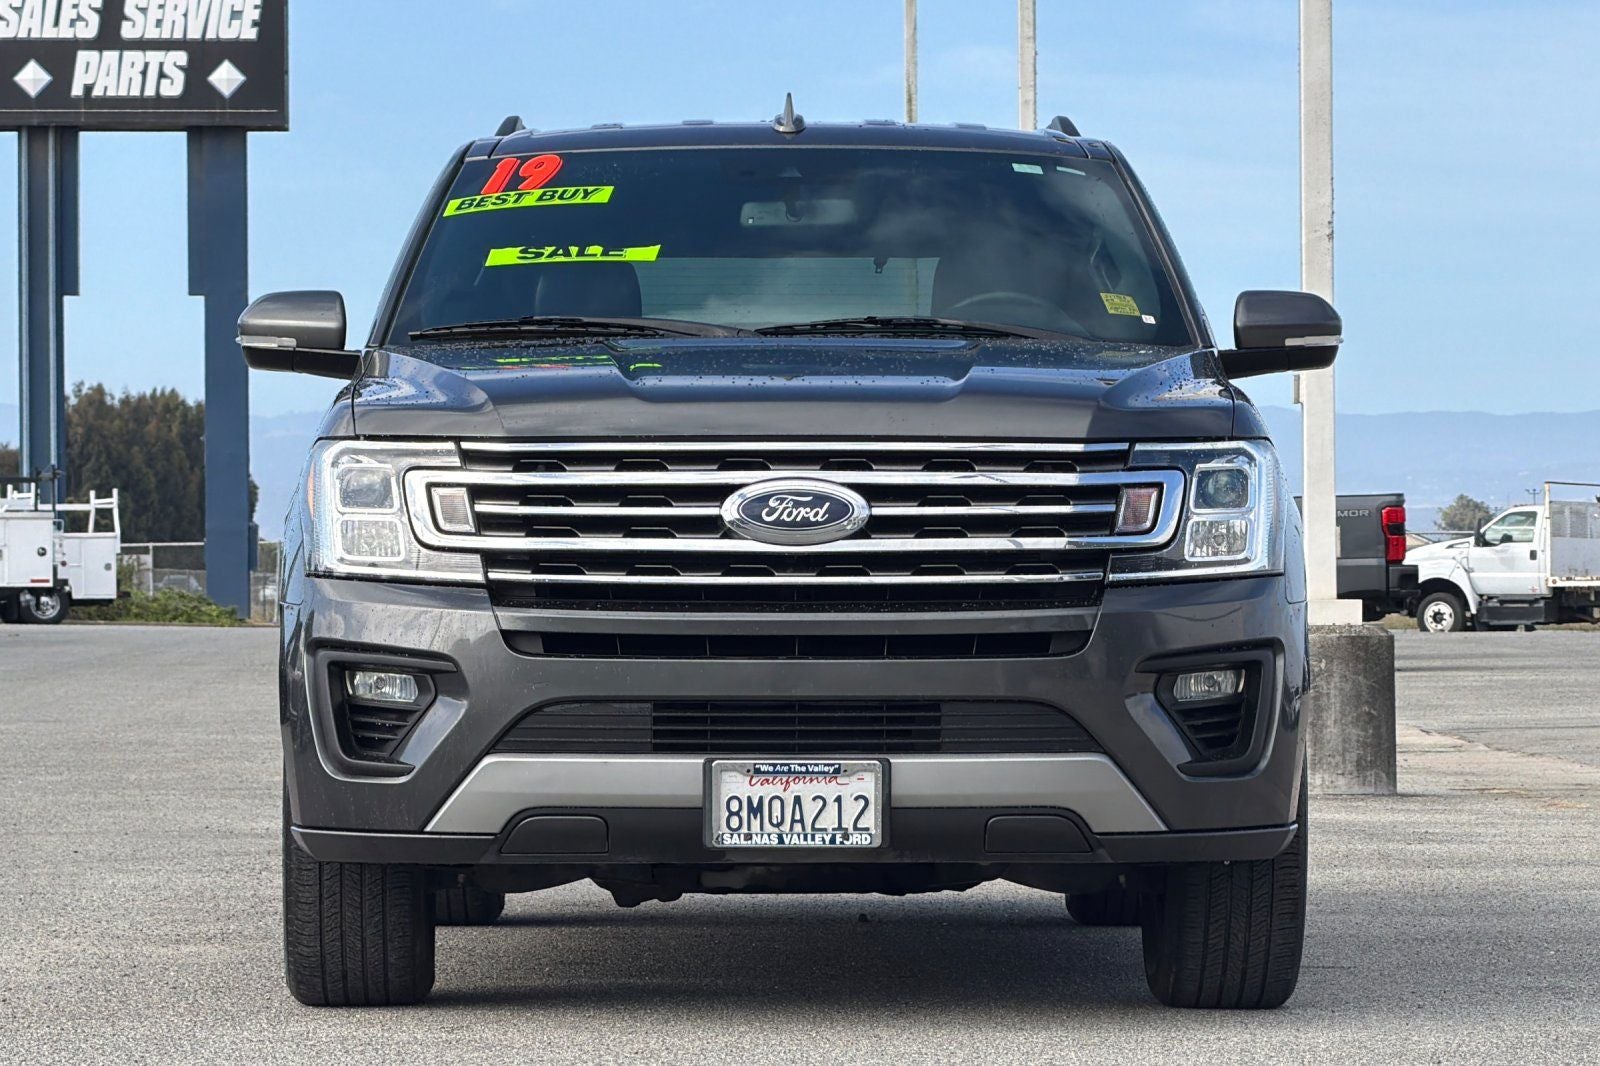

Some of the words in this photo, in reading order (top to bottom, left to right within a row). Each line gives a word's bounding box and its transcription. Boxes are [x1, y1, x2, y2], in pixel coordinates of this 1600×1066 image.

[0, 0, 104, 40] SALES
[120, 0, 263, 40] SERVICE
[70, 50, 188, 98] PARTS
[480, 154, 563, 195] 19
[455, 192, 532, 211] BEST
[535, 187, 603, 203] BUY
[516, 244, 628, 260] SALE
[761, 494, 831, 522] Ford
[775, 764, 789, 772] Are
[790, 764, 806, 772] The
[725, 794, 870, 833] 8MQA212
[783, 833, 832, 845] VALLEY
